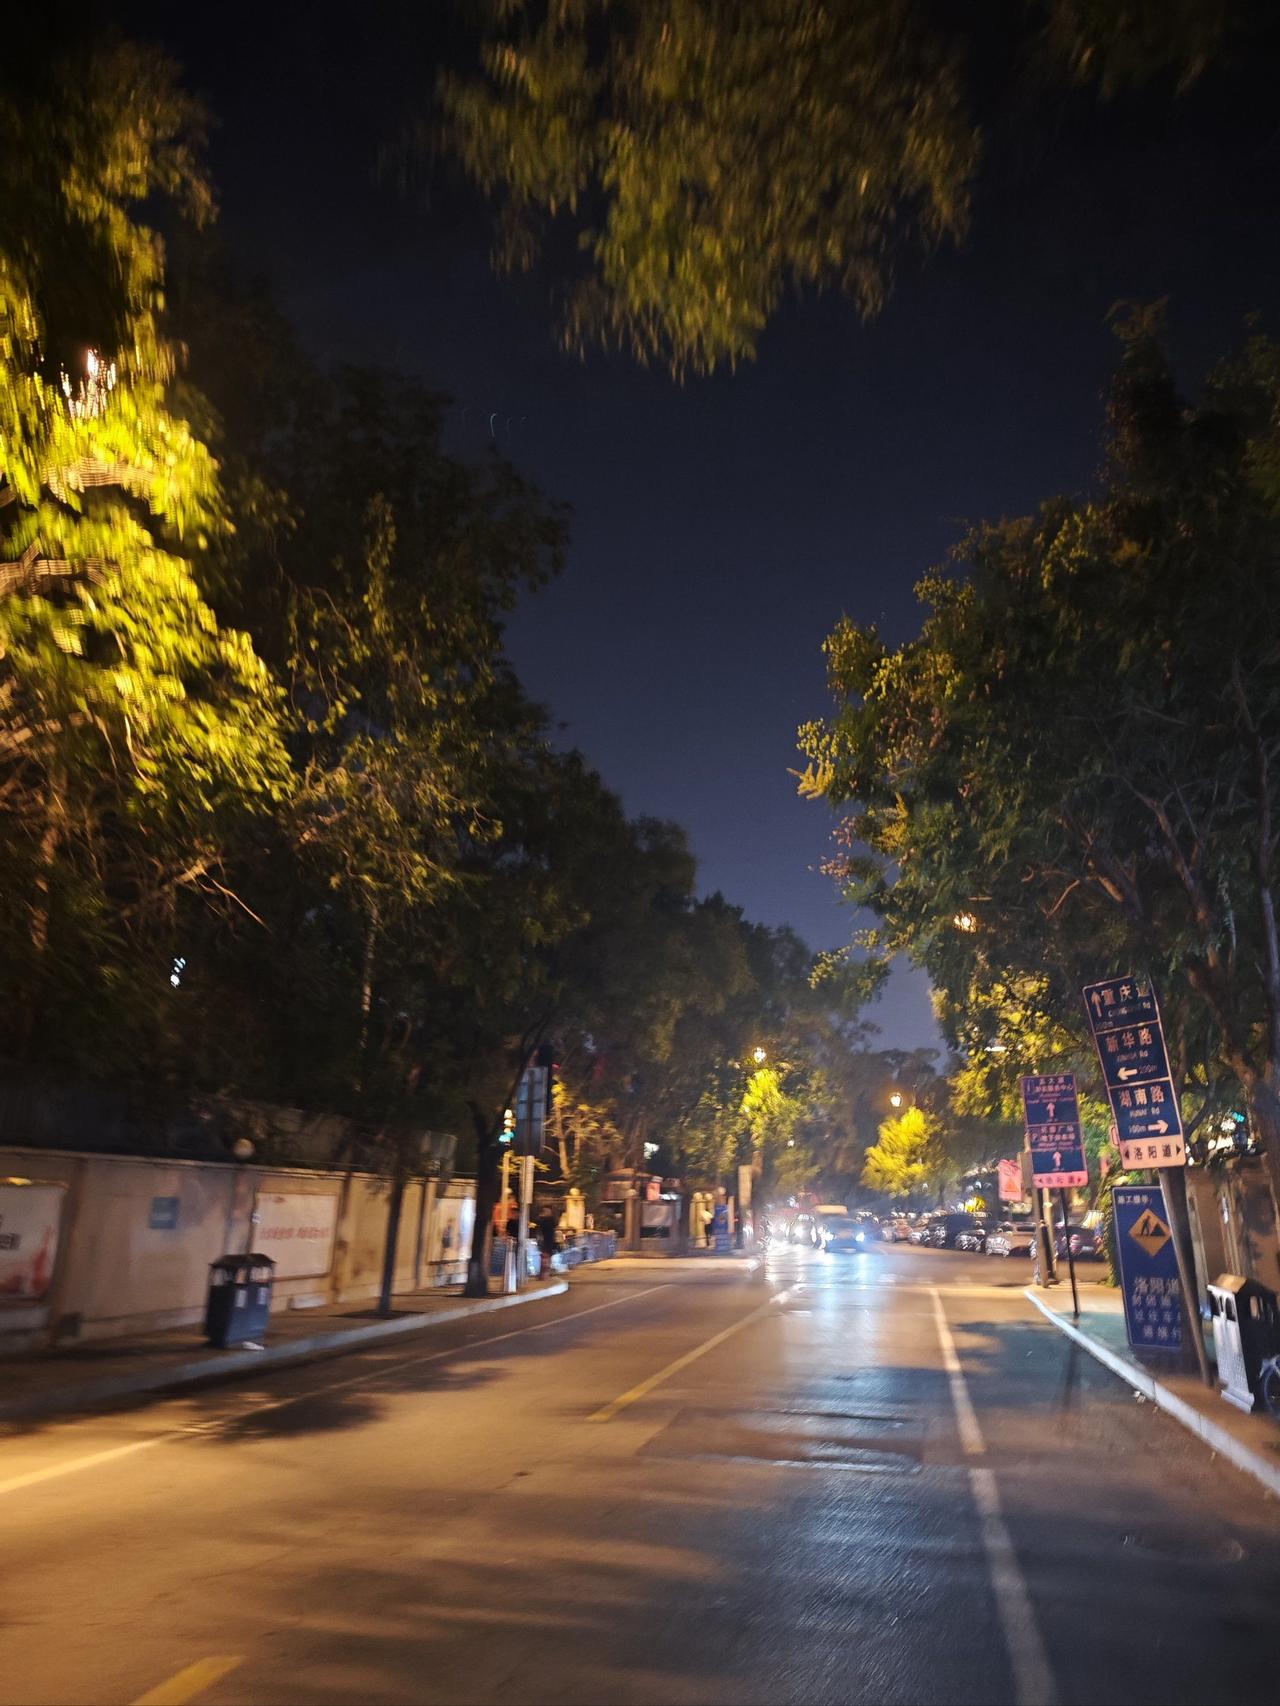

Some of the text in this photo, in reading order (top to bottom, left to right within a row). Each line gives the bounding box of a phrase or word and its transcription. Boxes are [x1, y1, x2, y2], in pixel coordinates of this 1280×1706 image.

[1105, 1027, 1153, 1053] 新华路
[1119, 1085, 1165, 1108] 湖南路
[1134, 1144, 1172, 1161] 洛阳道
